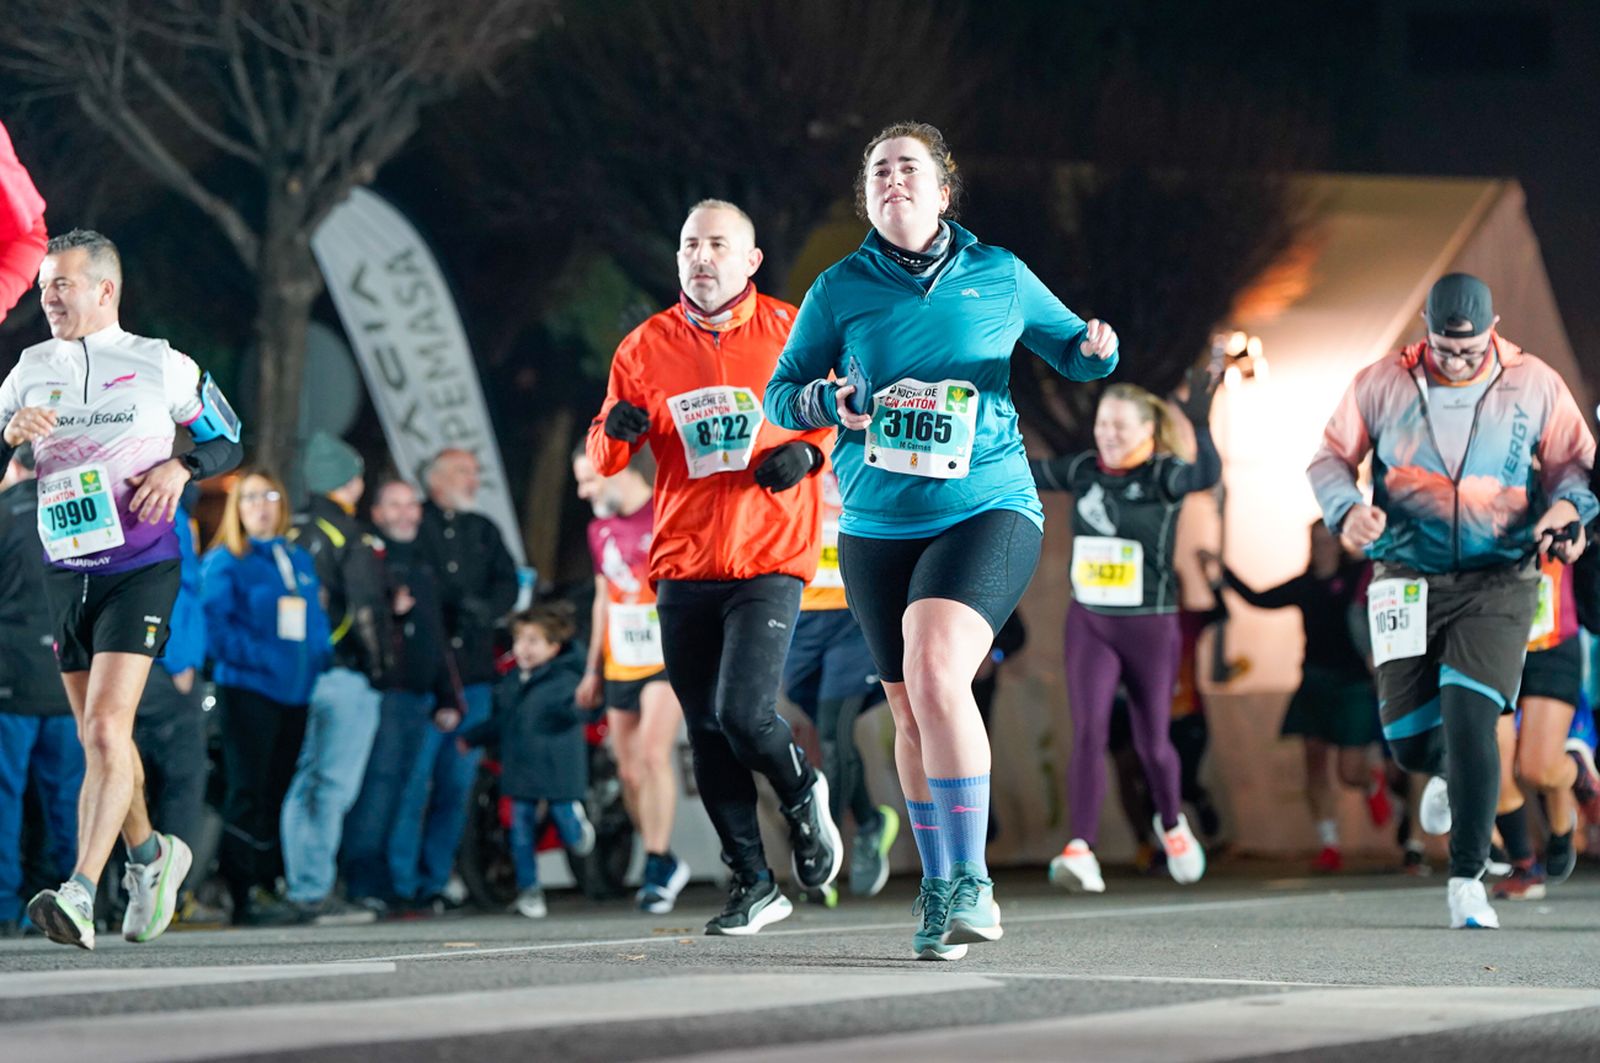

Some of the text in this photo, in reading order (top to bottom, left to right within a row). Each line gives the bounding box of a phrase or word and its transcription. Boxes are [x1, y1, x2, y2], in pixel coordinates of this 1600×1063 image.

[924, 388, 938, 397] DE
[87, 411, 134, 427] SEGURA
[884, 410, 952, 444] 3165
[47, 497, 97, 531] 7990
[1375, 607, 1410, 636] 1055
